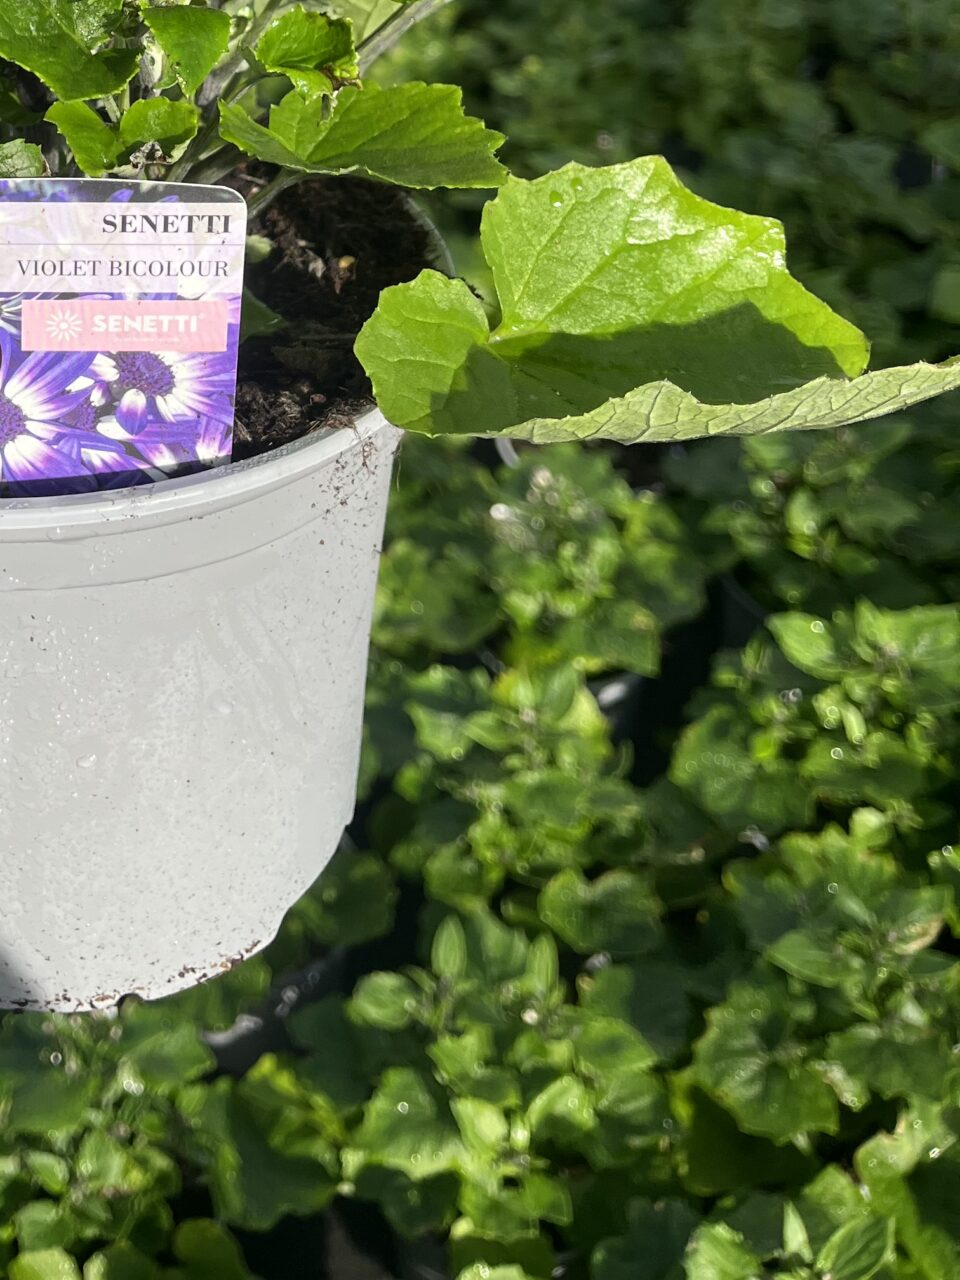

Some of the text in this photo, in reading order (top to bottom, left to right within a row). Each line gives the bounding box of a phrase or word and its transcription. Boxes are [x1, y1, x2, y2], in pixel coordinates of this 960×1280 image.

[102, 214, 233, 234] SENETTI
[16, 259, 229, 277] VIOLET BICOLOUR
[92, 314, 198, 332] SENETTI
